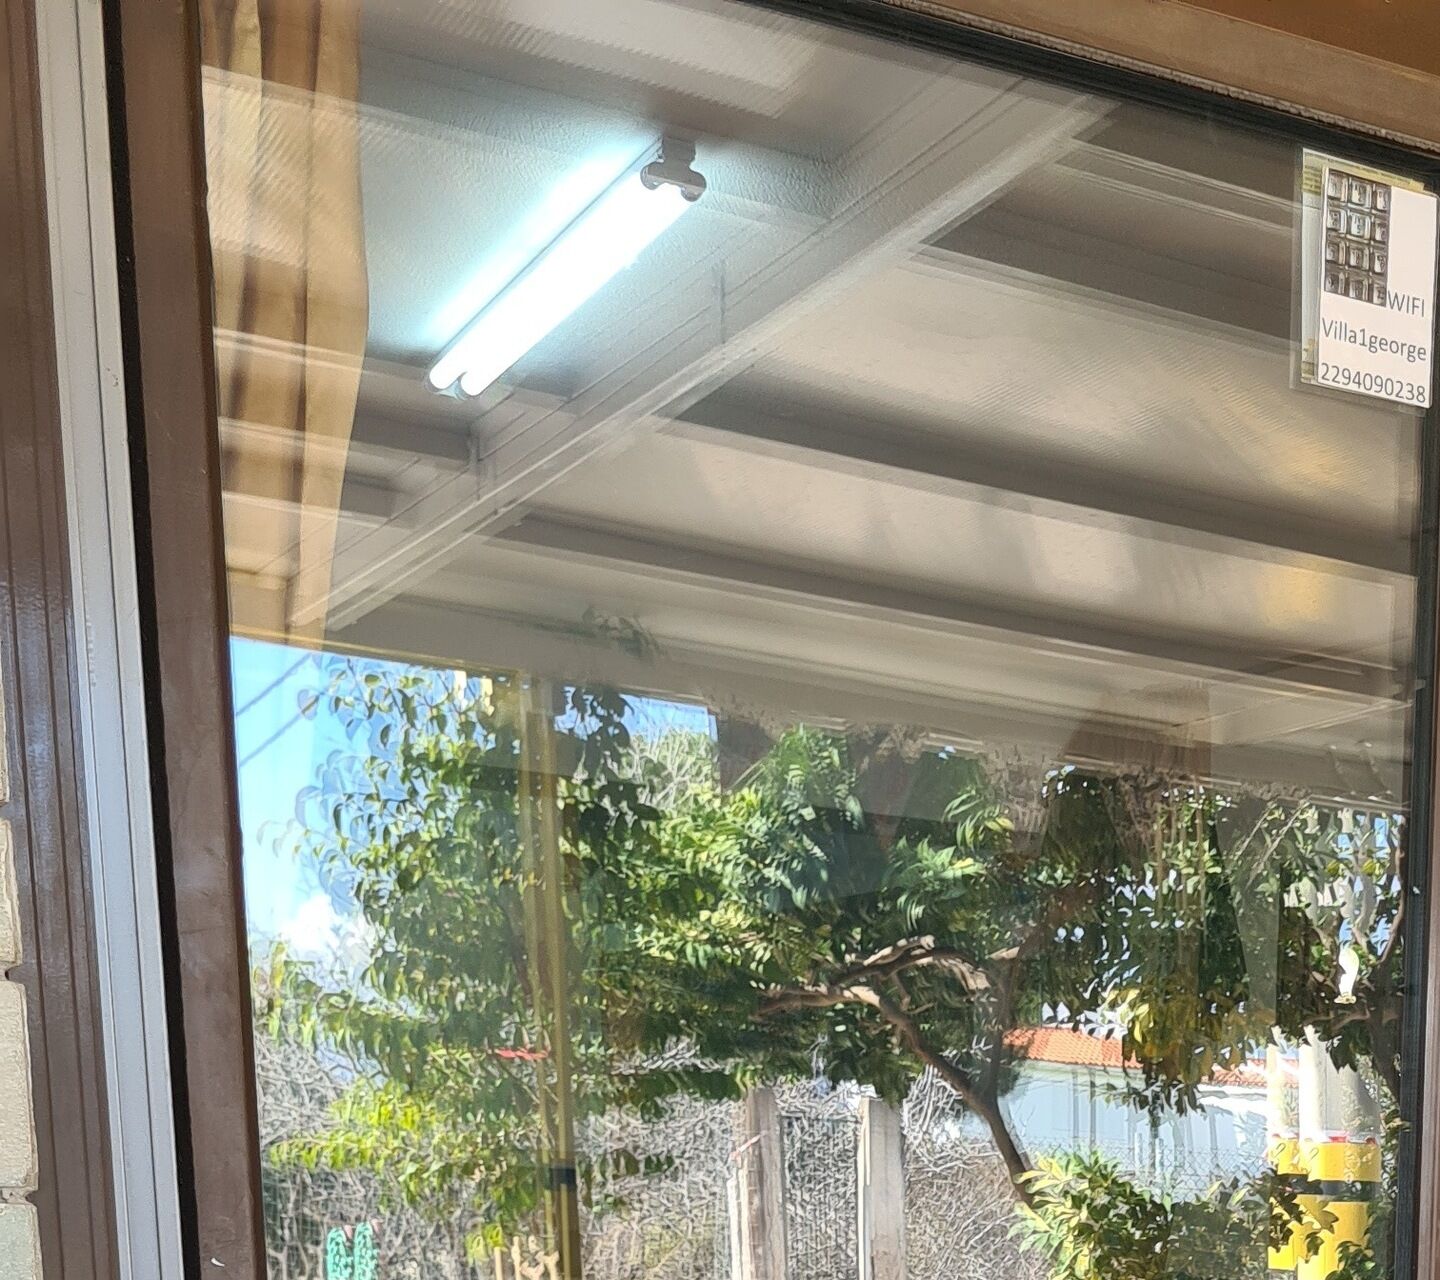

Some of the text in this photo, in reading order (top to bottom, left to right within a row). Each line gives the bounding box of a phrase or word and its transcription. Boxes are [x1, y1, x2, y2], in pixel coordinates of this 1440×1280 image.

[1388, 290, 1425, 317] WIFI
[1322, 317, 1426, 362] Villa1george
[1321, 363, 1425, 403] 2294090238
